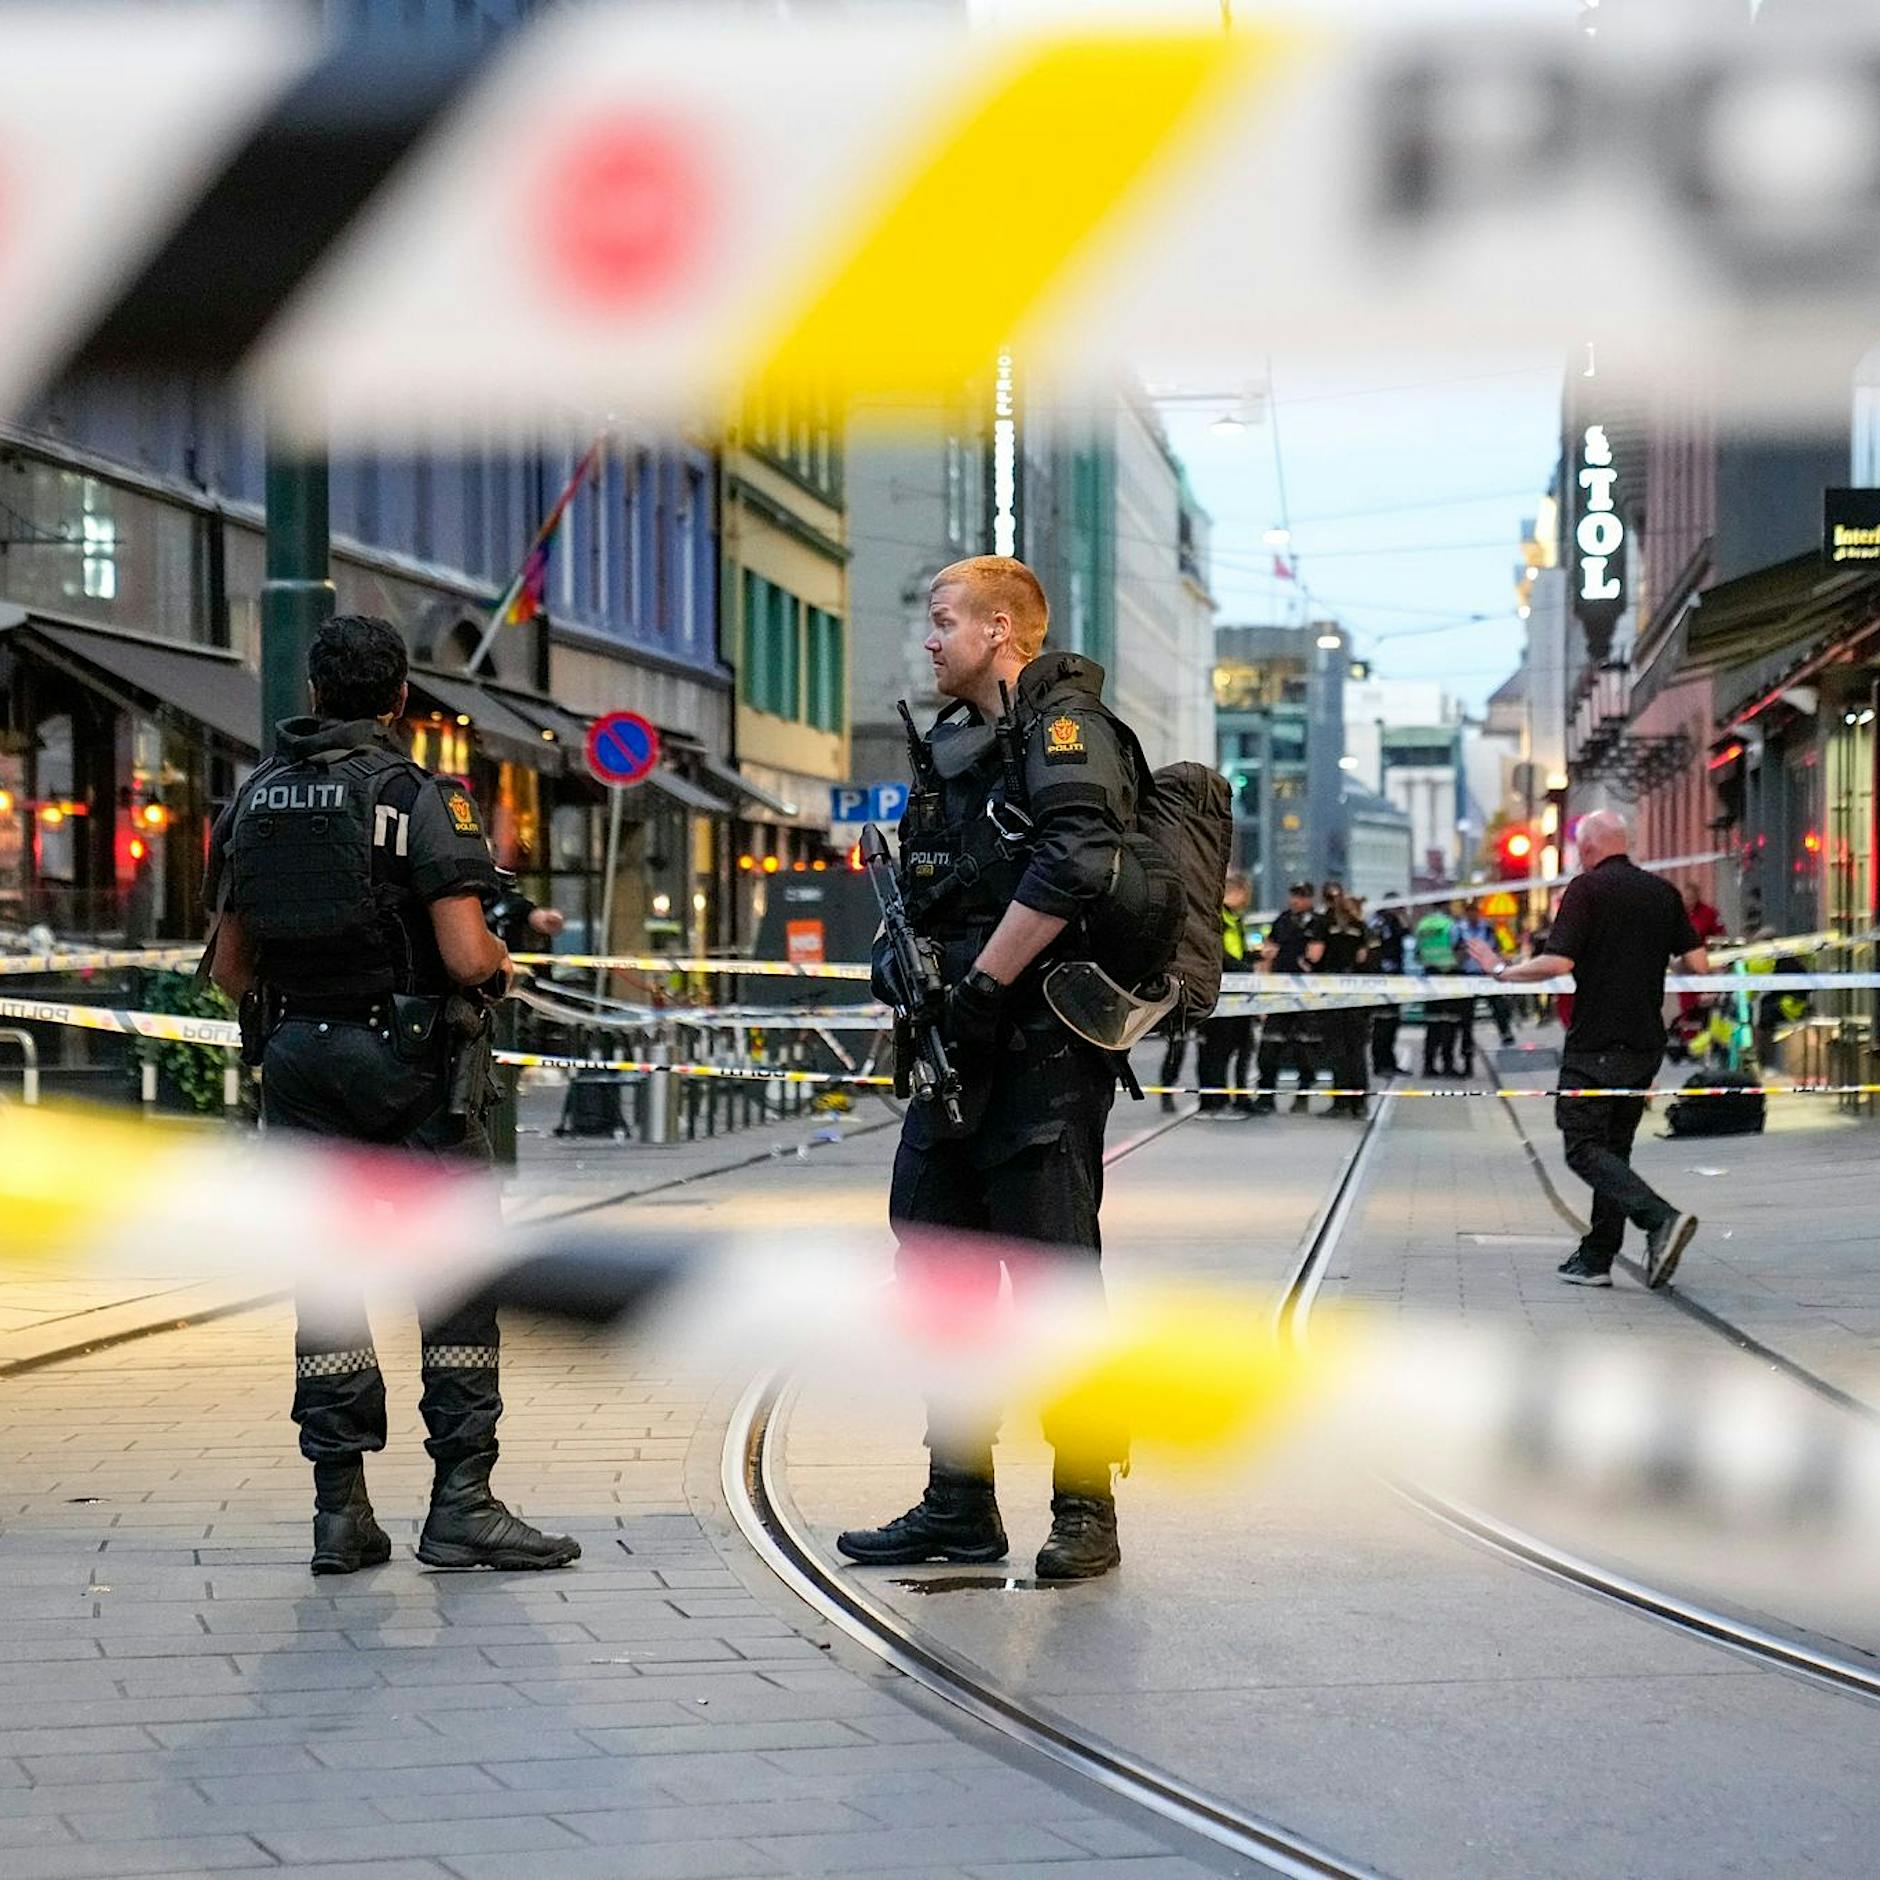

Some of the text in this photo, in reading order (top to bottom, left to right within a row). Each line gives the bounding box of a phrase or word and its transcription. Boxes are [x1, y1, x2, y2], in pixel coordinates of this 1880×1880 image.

[251, 784, 344, 811] POLITI
[839, 788, 901, 819] P P
[910, 851, 950, 865] POLITI
